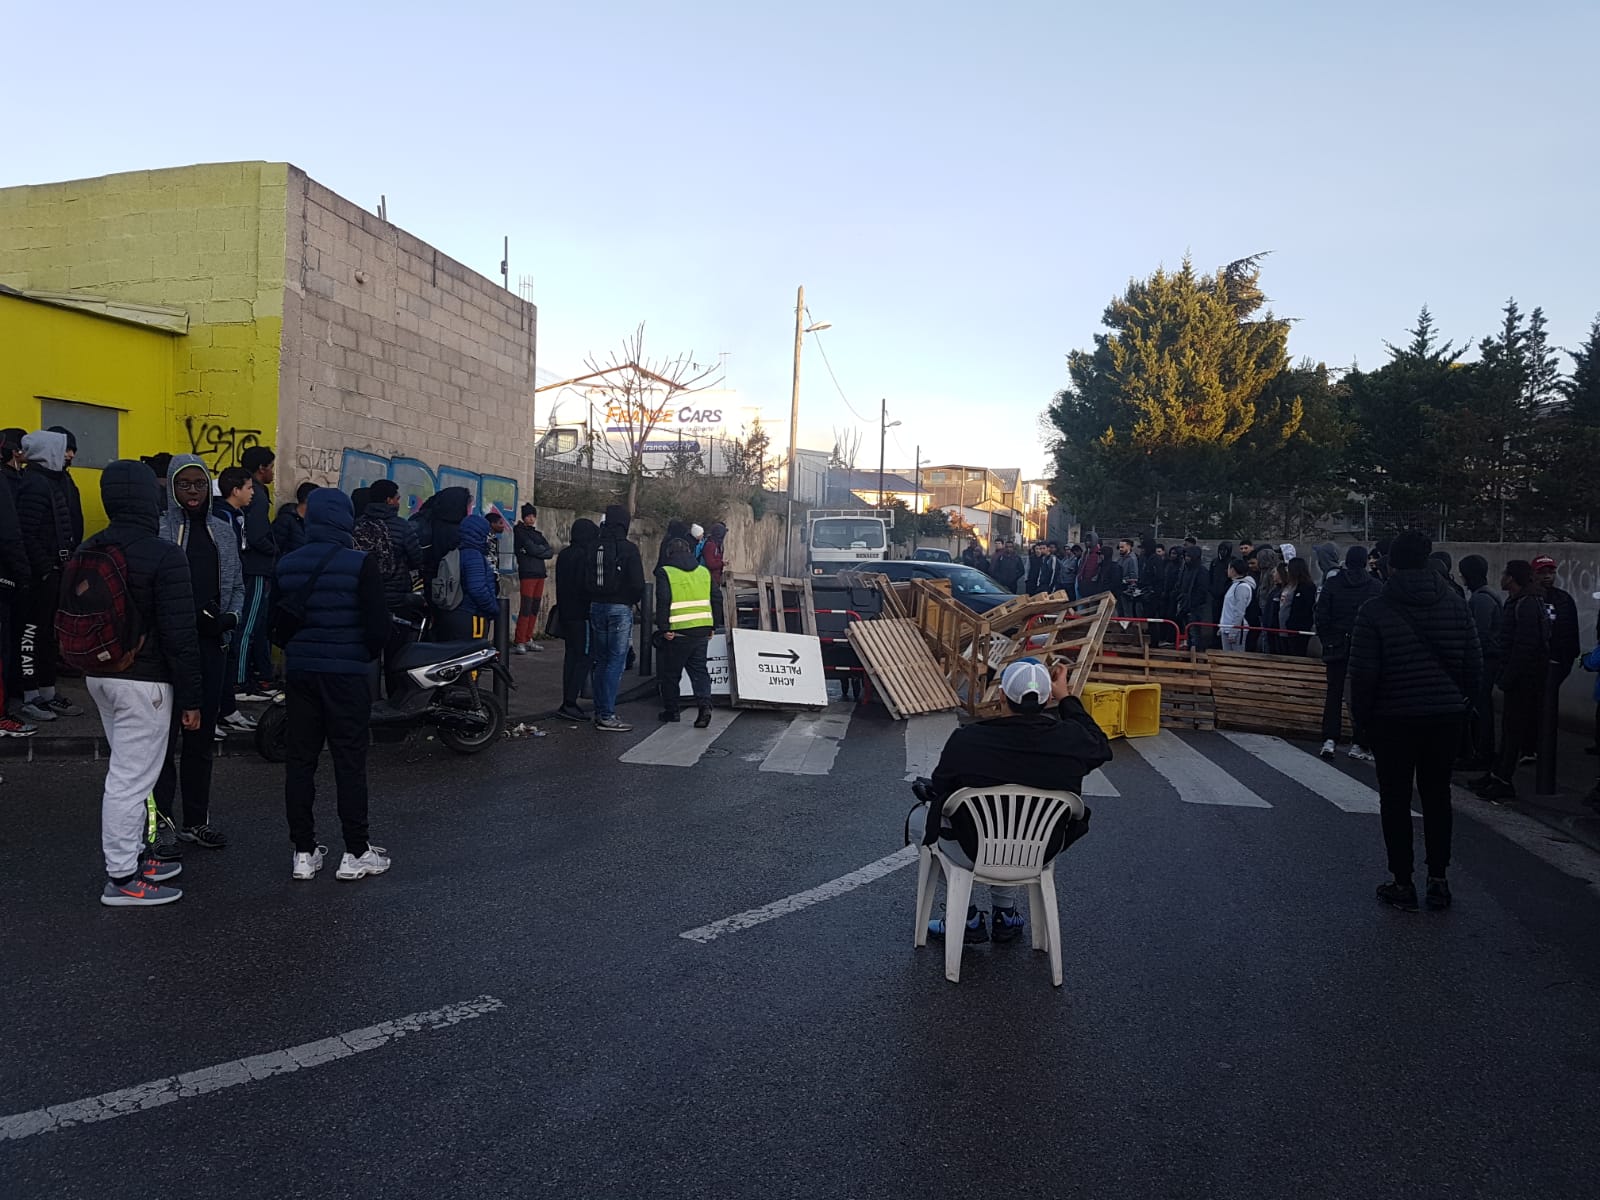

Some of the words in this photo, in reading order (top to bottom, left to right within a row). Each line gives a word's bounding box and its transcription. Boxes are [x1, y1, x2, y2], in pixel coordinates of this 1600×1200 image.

[678, 406, 723, 423] CARS
[21, 623, 38, 652] NIKE
[20, 654, 34, 676] AIR
[758, 663, 802, 675] PALETTES
[768, 676, 795, 687] ACHAT
